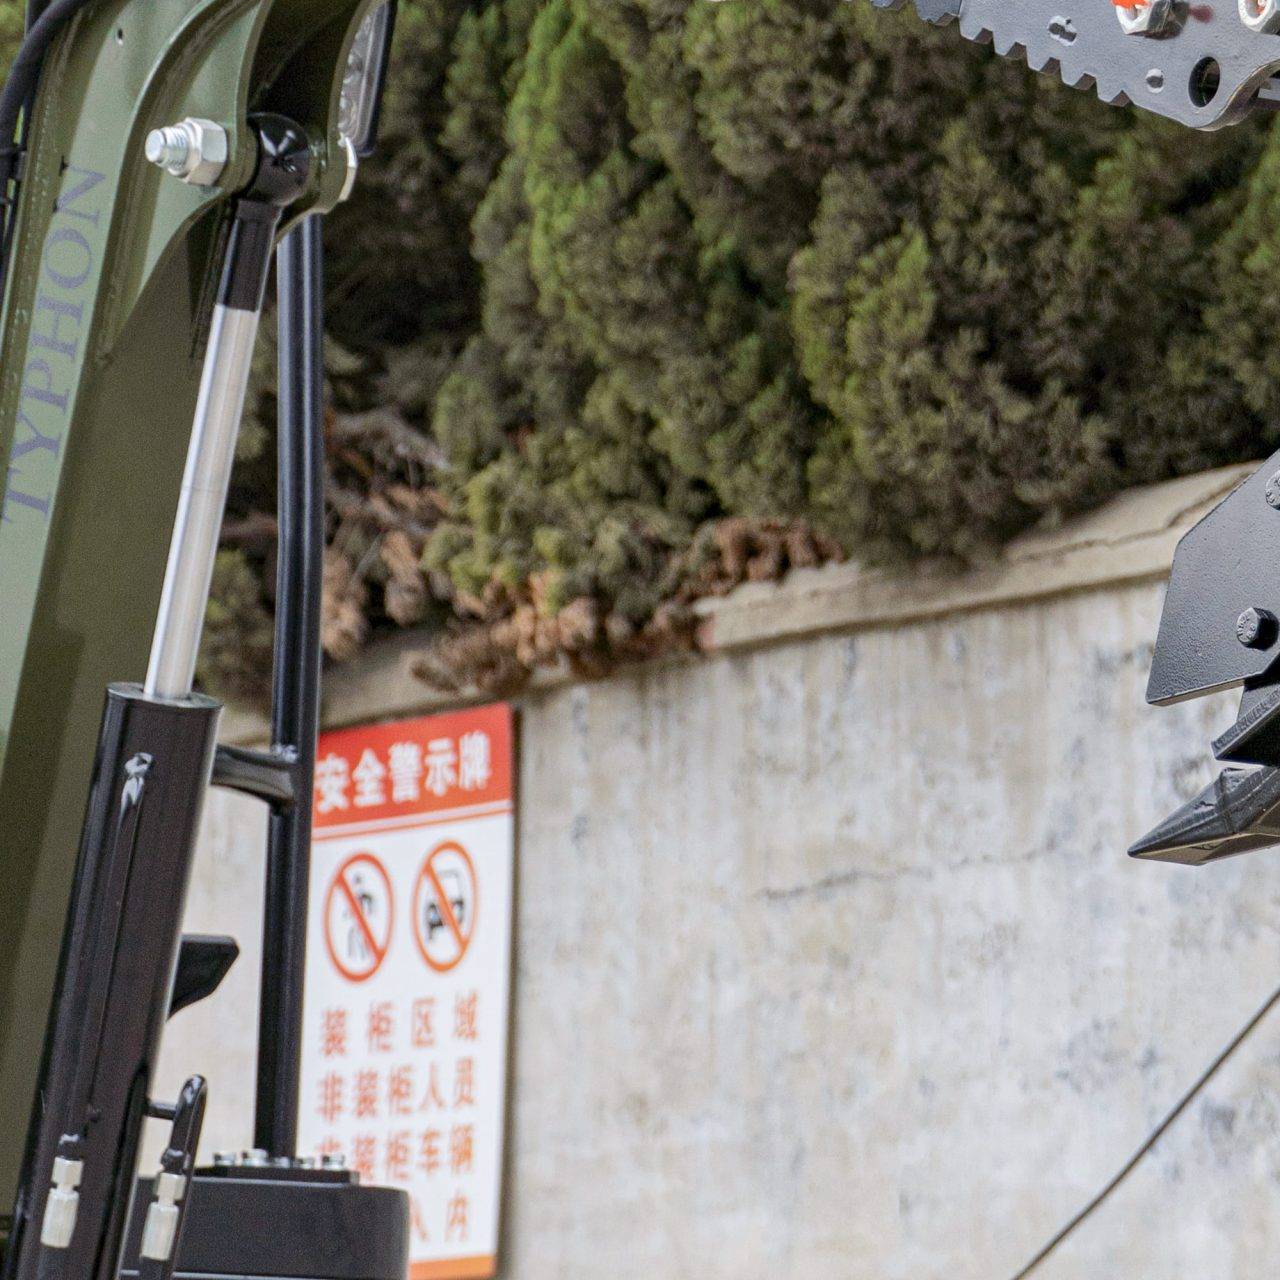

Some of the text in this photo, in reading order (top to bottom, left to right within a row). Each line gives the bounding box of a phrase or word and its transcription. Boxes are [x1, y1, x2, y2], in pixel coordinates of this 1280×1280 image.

[3, 164, 106, 523] TYPHON
[314, 730, 491, 814] 安全警示牌
[321, 988, 479, 1056] 装柜区域
[315, 1056, 475, 1122] 非装柜人员
